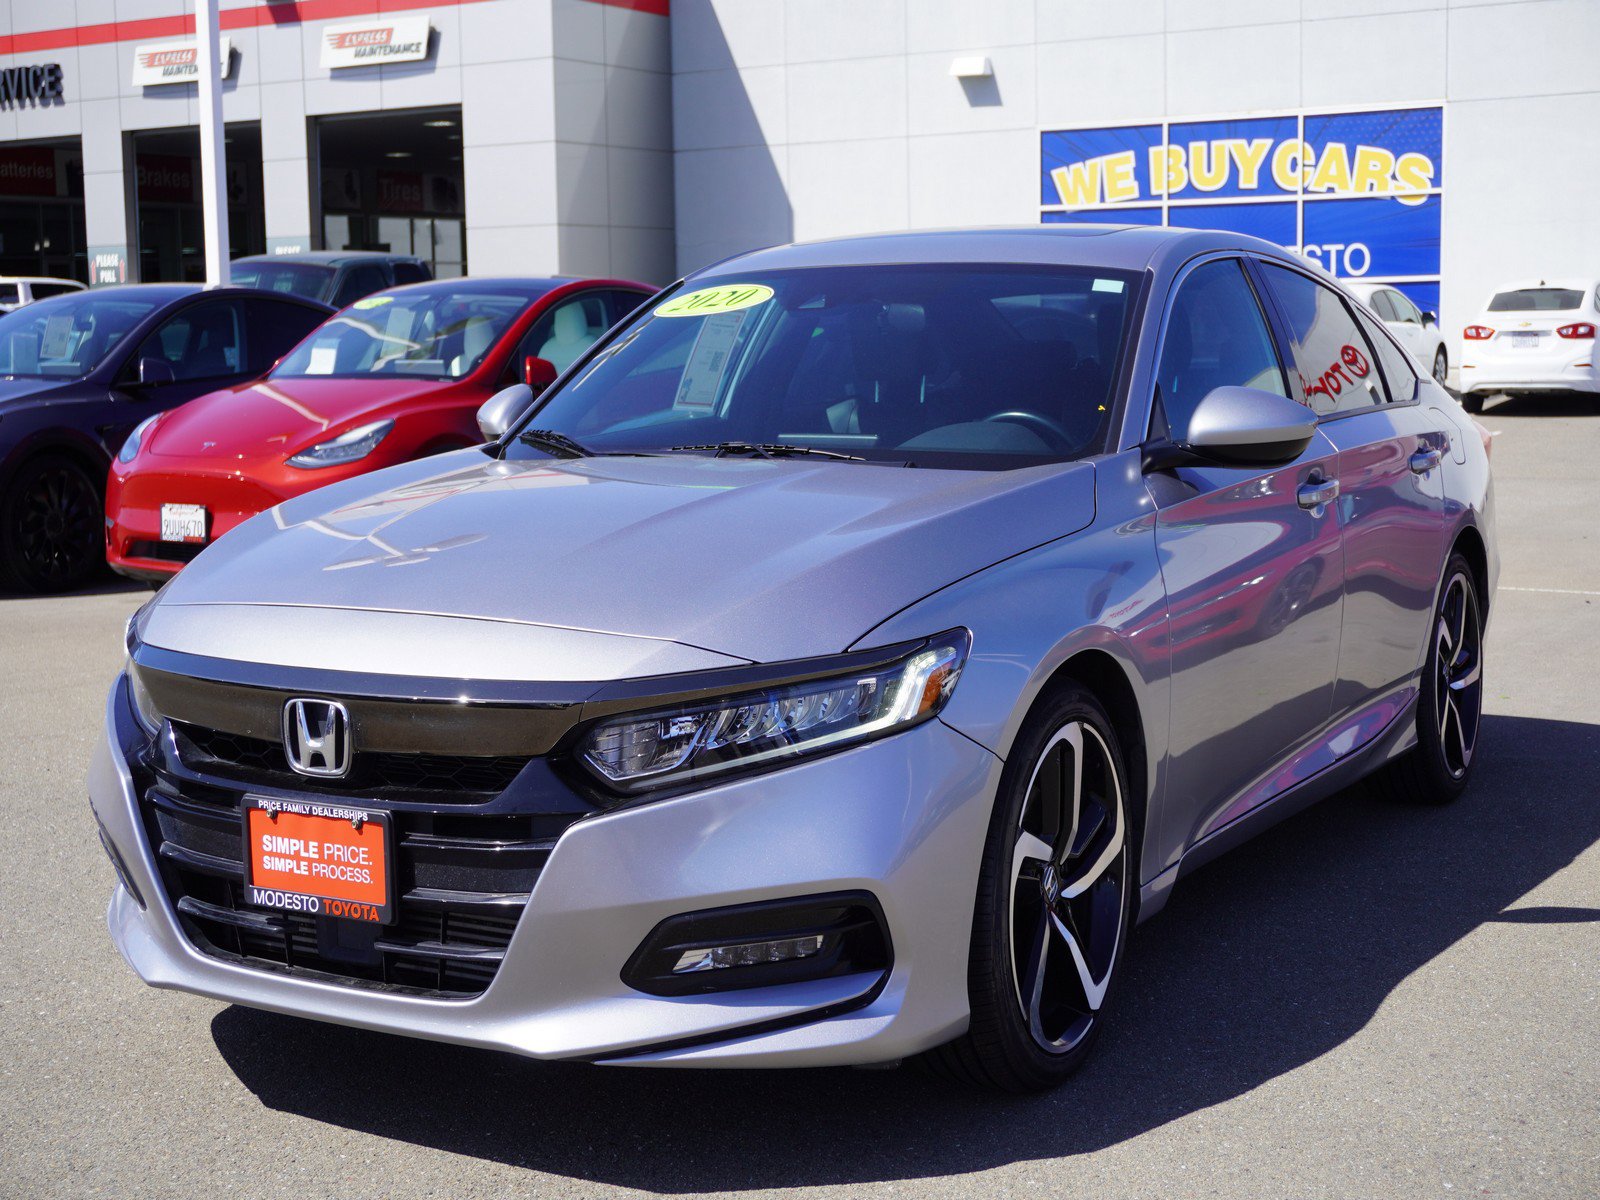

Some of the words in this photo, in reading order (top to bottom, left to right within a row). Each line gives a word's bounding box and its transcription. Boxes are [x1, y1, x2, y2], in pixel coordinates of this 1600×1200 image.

[344, 30, 388, 46] EXPRESS
[153, 51, 194, 66] EXPRESS
[354, 42, 422, 58] MAINTENANCE
[137, 166, 190, 188] Brakes
[1050, 150, 1140, 211] WE
[1148, 138, 1274, 197] BUY
[1271, 138, 1435, 207] CARS
[379, 178, 421, 201] Tires
[1285, 242, 1371, 278] STO
[99, 269, 117, 284] PULL
[667, 288, 759, 313] 2020
[163, 519, 202, 537] 9UUH670
[258, 799, 282, 811] PRICE
[283, 802, 310, 814] FAMILY
[312, 806, 369, 821] DEALERSHIPS
[262, 834, 319, 859] SIMPLE
[323, 843, 373, 866] PRICE.
[262, 855, 309, 876] SIMPLE
[312, 862, 374, 884] PROCESS.
[253, 888, 319, 913] MODESTO
[323, 898, 381, 922] TOYOTA
